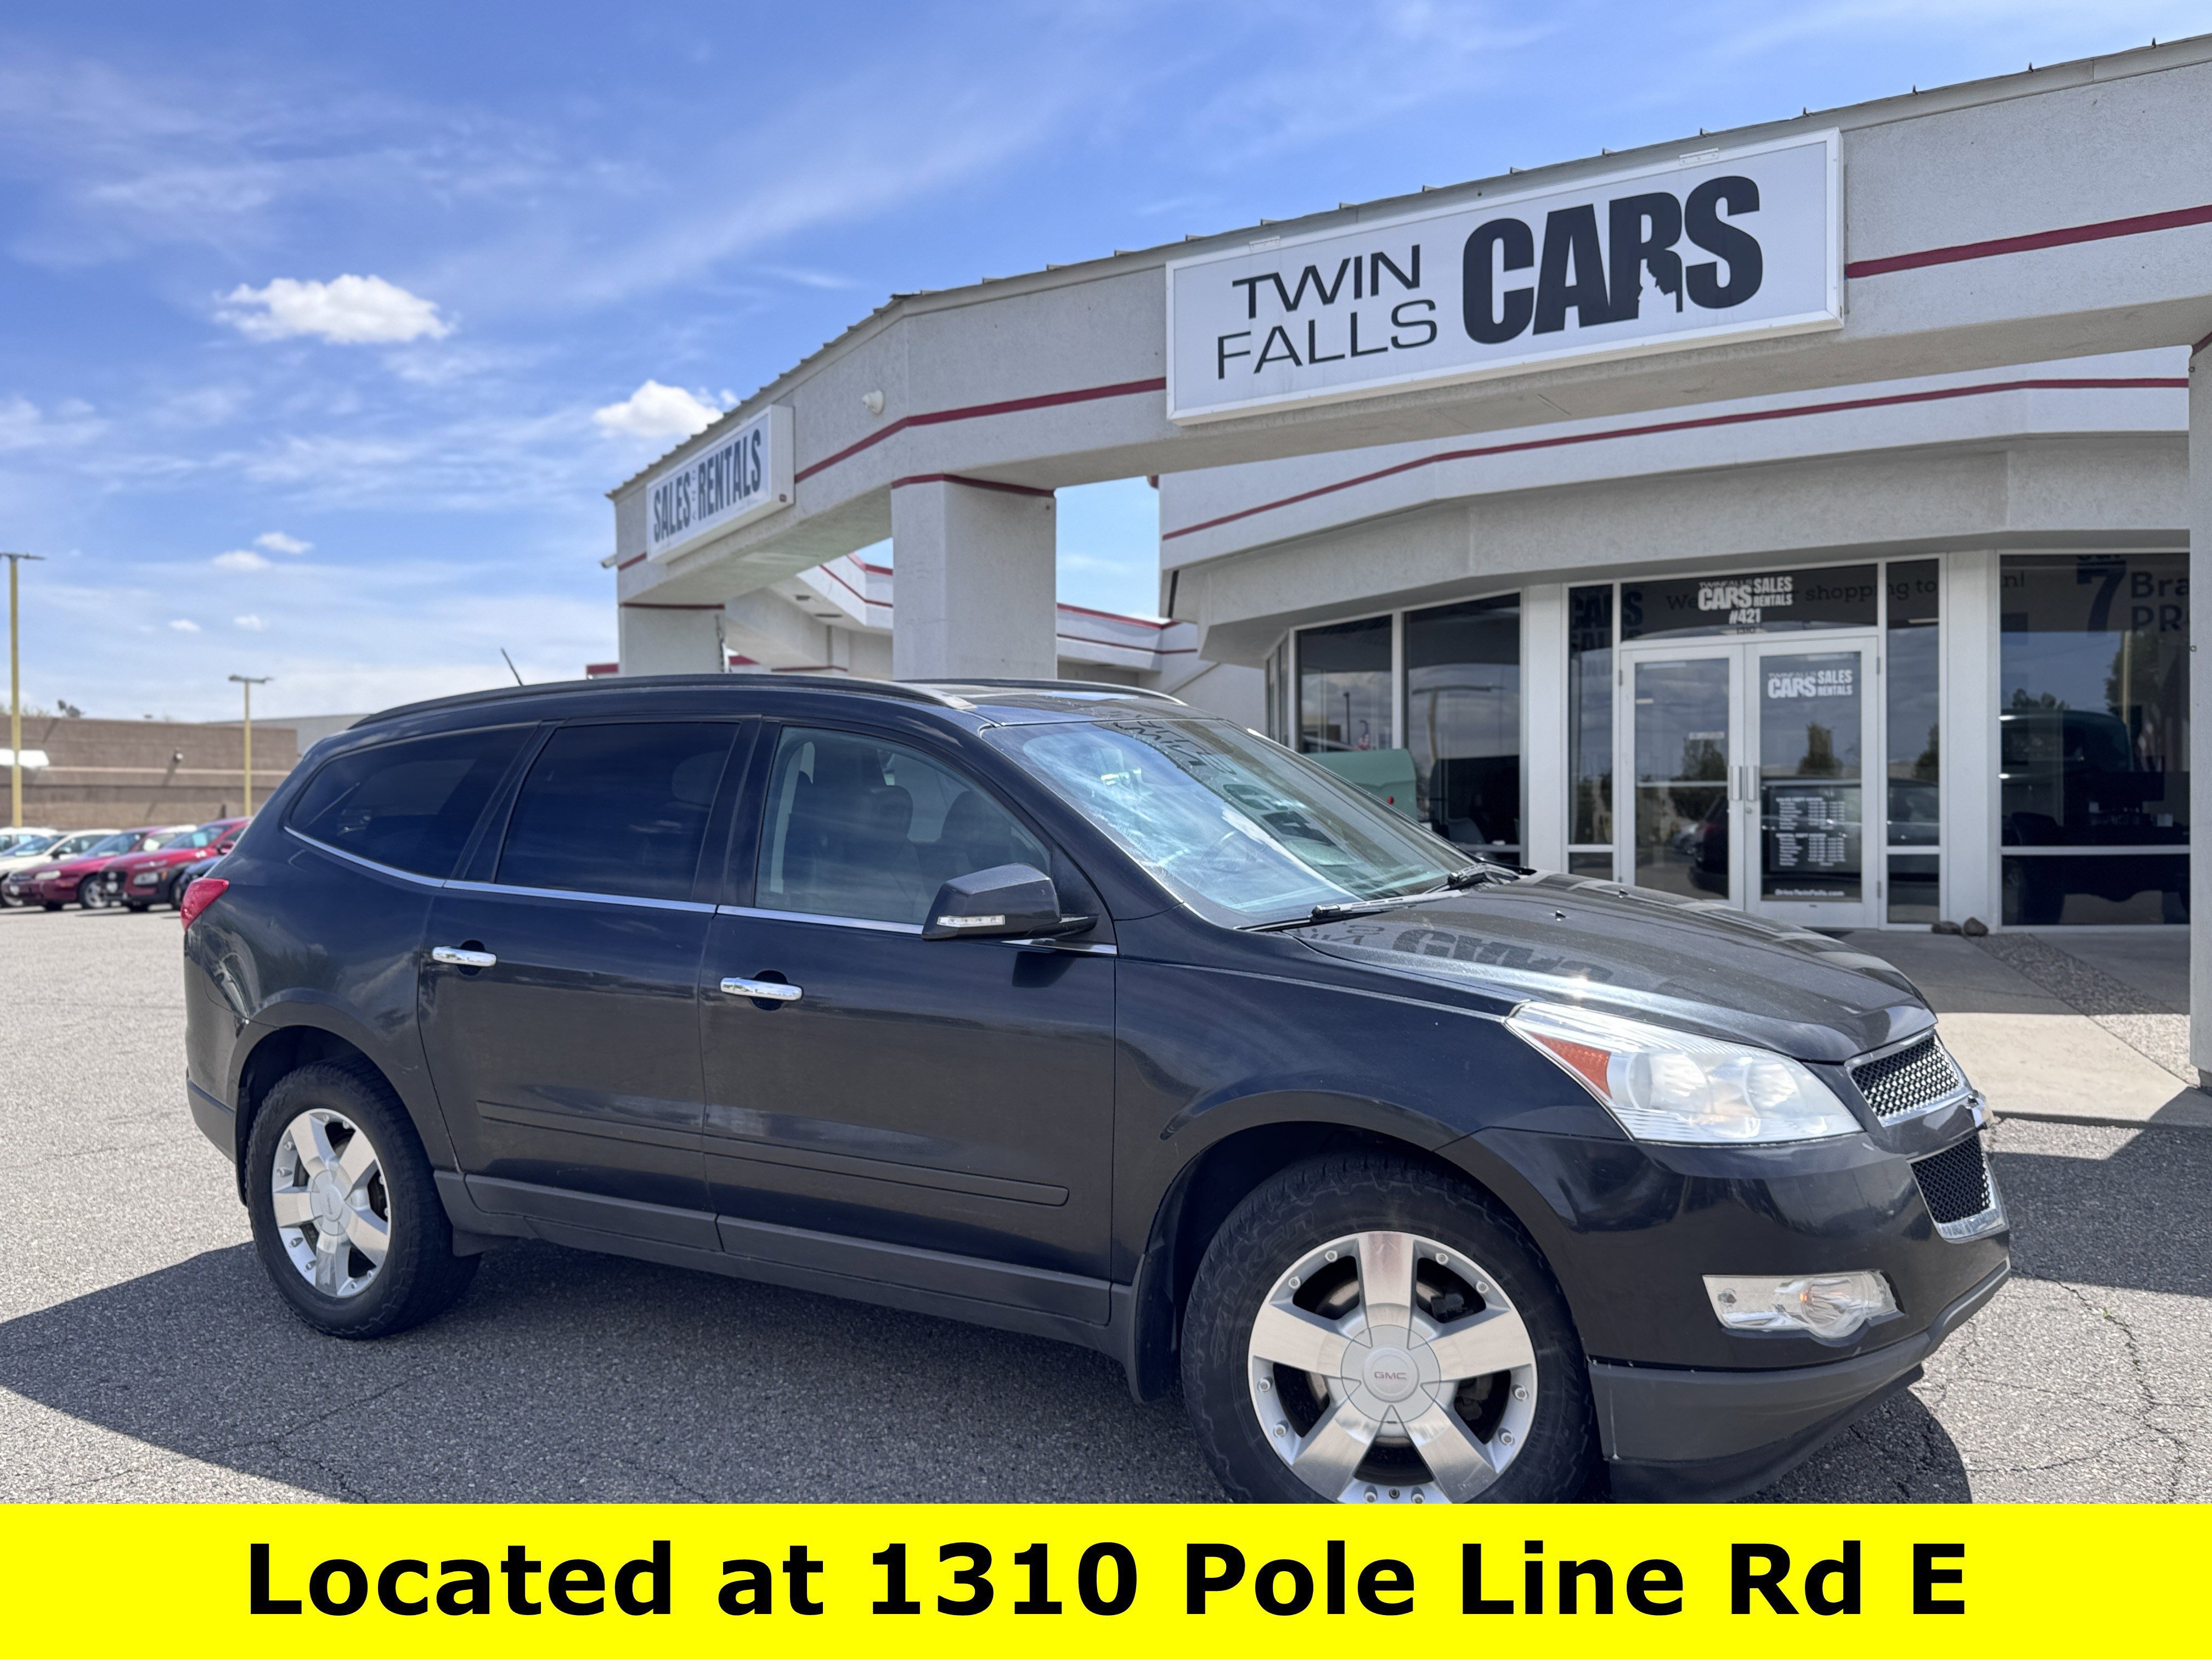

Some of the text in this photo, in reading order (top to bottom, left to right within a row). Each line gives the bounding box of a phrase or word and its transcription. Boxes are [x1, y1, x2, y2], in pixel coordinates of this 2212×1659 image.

[1463, 176, 1763, 344] CARS
[1233, 245, 1420, 319] TWIN
[1218, 300, 1437, 379] FALLS
[654, 471, 691, 543] SALES
[698, 429, 761, 521] RENTALS
[1753, 576, 1793, 594] SALES
[1698, 585, 1753, 611] CARS
[1753, 593, 1793, 607] RENTALS
[1729, 607, 1762, 625] #421
[1817, 669, 1853, 685] SALES
[1768, 676, 1817, 699] CARS
[1818, 684, 1853, 697] RENTALS
[1374, 1371, 1407, 1380] GMC
